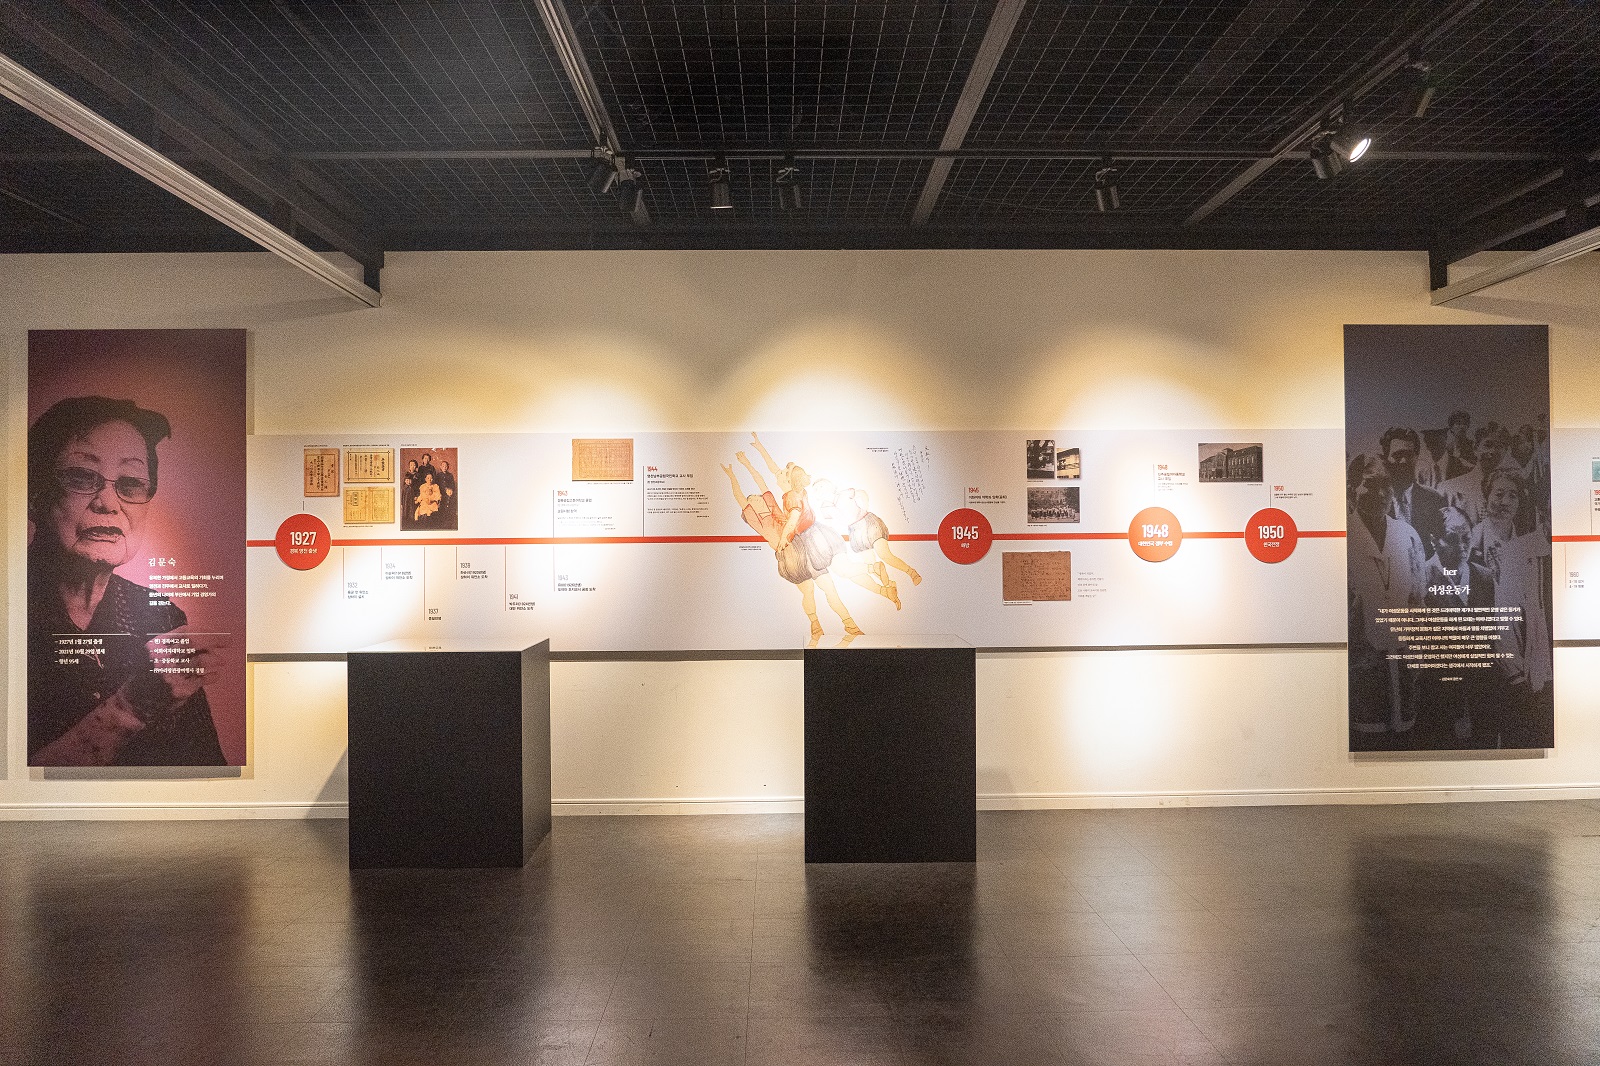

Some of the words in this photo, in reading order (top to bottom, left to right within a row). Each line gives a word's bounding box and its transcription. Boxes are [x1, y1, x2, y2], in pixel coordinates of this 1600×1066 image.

[951, 526, 979, 540] 1945
[1142, 524, 1169, 538] 1948
[1258, 525, 1284, 539] 1950
[290, 531, 317, 546] 1927
[1443, 567, 1458, 575] her
[1428, 585, 1471, 595] 여성운동가
